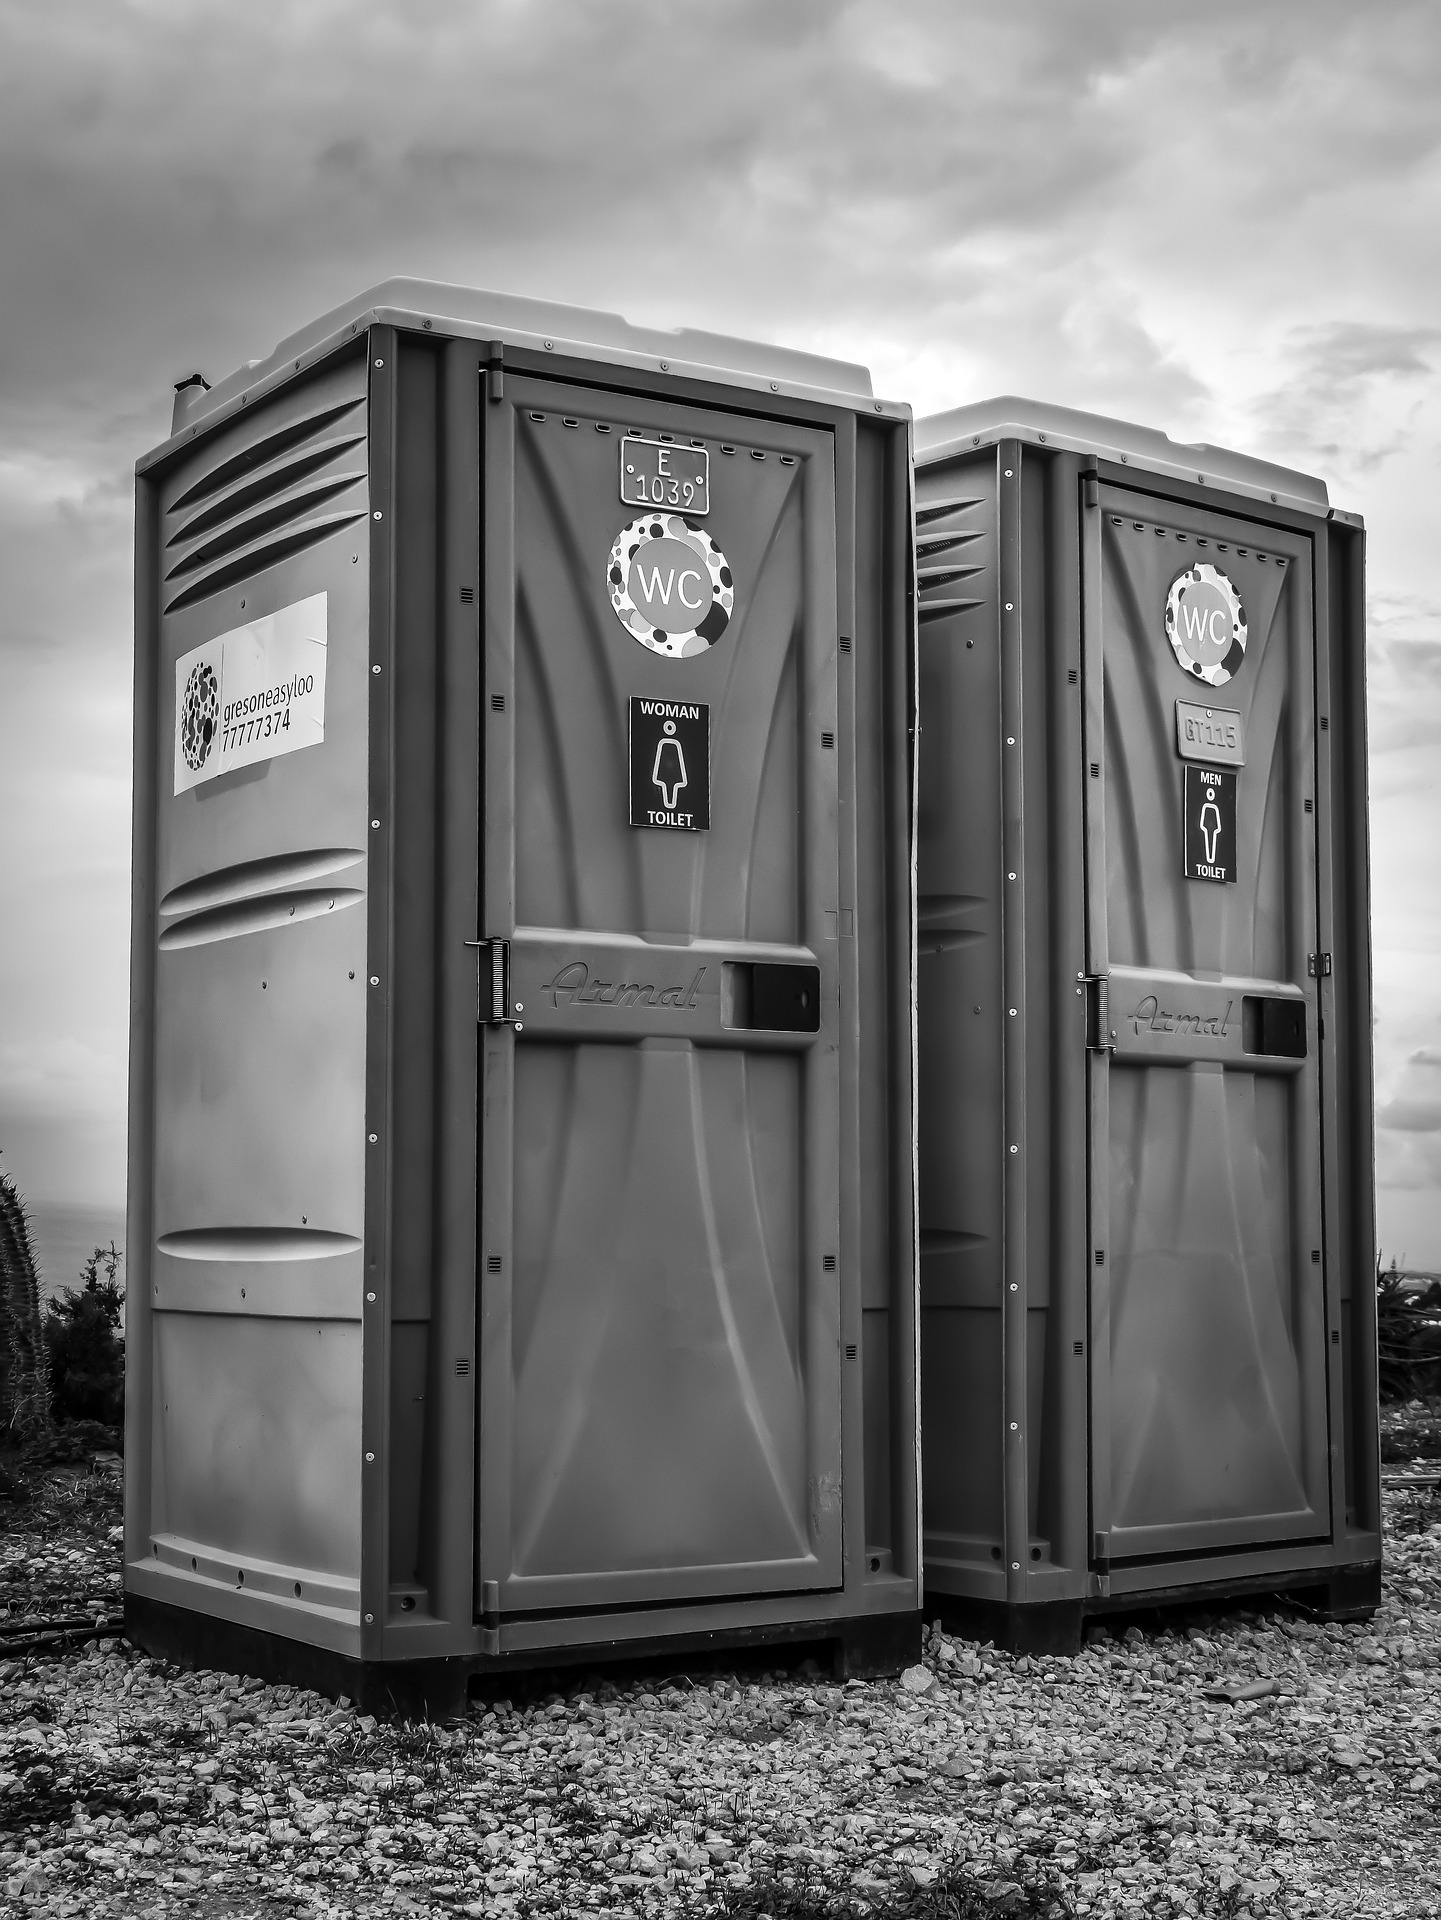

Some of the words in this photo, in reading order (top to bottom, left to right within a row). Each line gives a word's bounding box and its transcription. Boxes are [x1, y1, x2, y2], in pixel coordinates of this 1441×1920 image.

[658, 449, 672, 477] E
[636, 474, 695, 507] 1039
[636, 564, 703, 609] WC
[1182, 604, 1227, 645] WC
[223, 673, 314, 728] gresoneasyloo
[640, 701, 699, 720] WOMAN
[222, 708, 291, 752] 77777374
[1184, 716, 1237, 749] GT115
[1200, 771, 1222, 786] MEN
[647, 810, 694, 827] TOILET
[1195, 863, 1226, 880] TOILET
[540, 961, 707, 1011] Armal
[1126, 995, 1234, 1039] Armal
